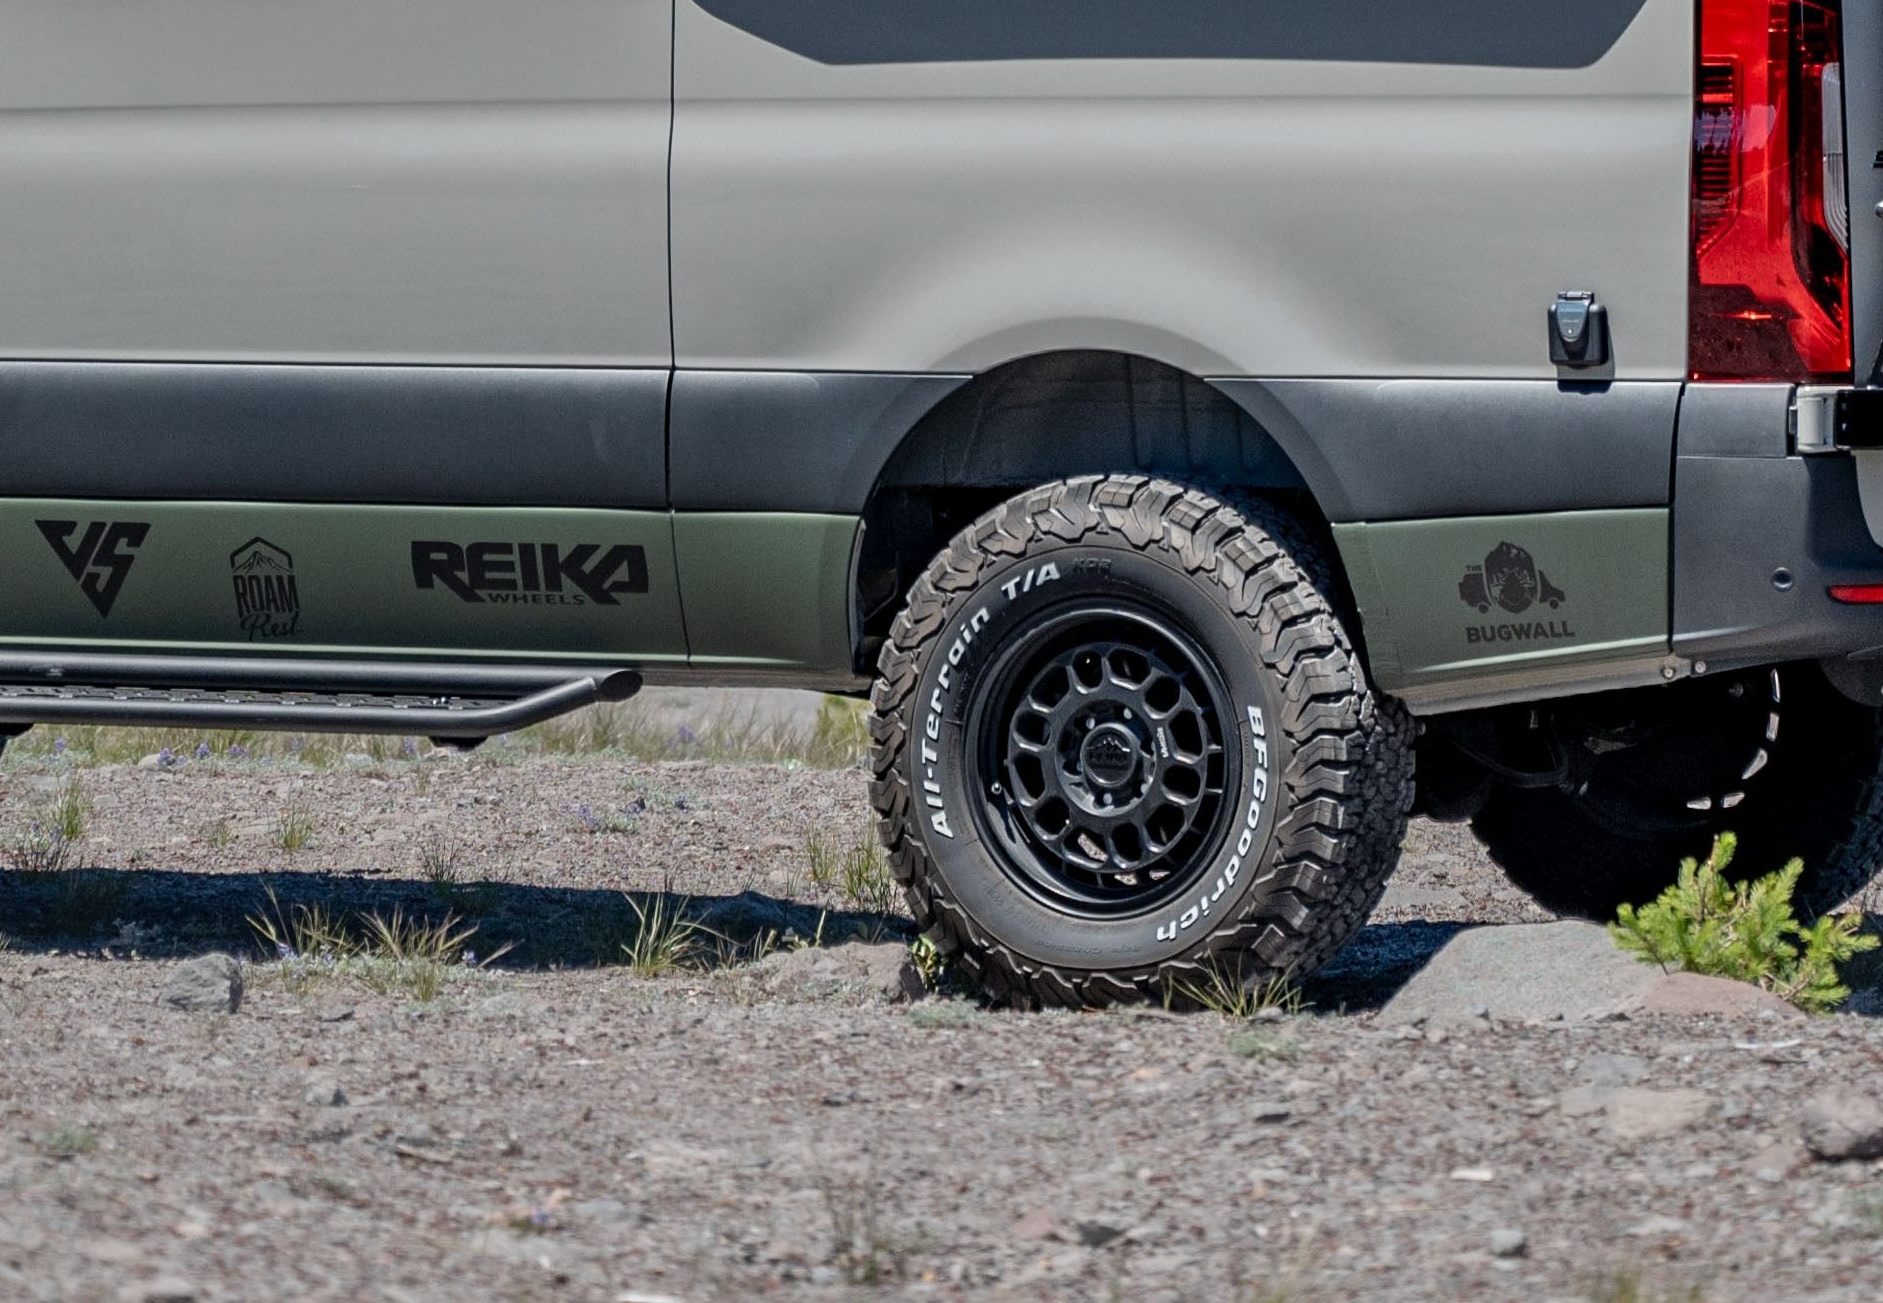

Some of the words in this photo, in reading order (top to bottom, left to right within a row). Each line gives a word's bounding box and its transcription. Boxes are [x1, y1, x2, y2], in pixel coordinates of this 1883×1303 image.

[232, 574, 301, 619] ROAM
[410, 540, 650, 606] REIKA
[486, 591, 586, 607] WHEELS
[1464, 620, 1576, 644] BUGWALL
[921, 606, 989, 839] All-Terrain
[1001, 561, 1061, 601] T/A
[1156, 704, 1269, 943] BFGoodrich
